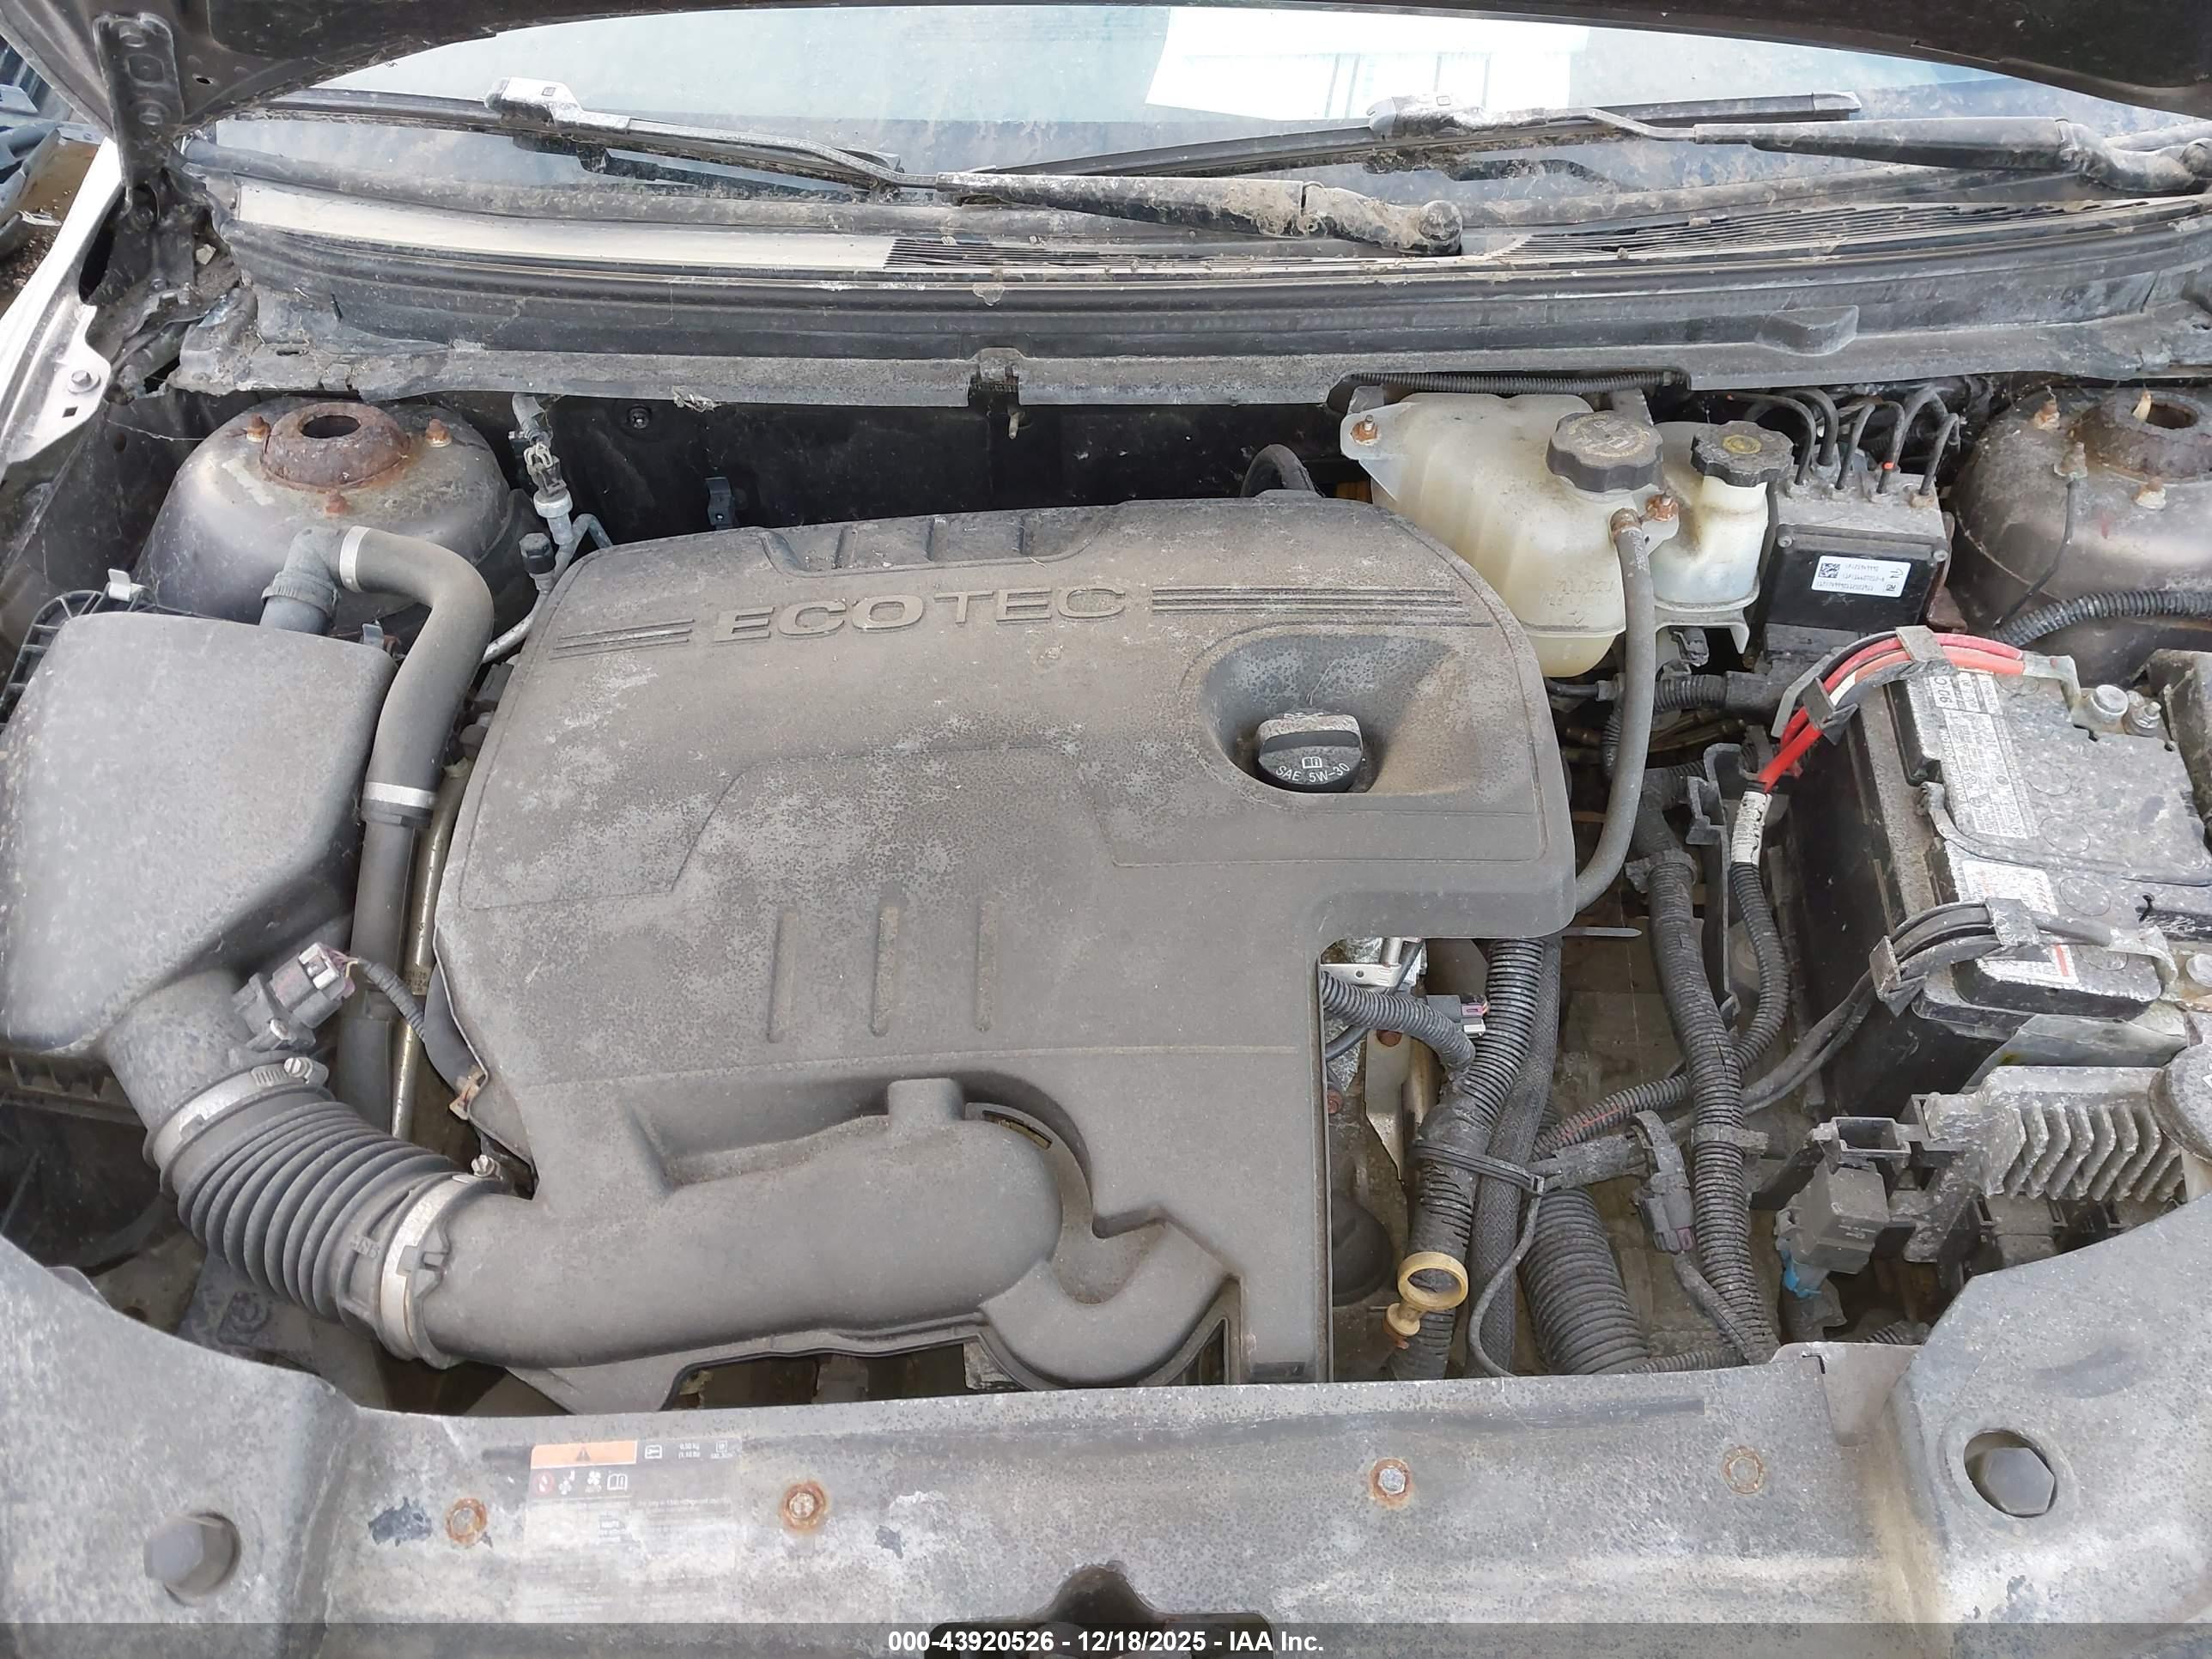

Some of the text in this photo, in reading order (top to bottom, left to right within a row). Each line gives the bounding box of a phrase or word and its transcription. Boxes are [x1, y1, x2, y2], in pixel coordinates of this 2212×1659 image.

[714, 582, 1127, 643] ECOTEC
[1275, 763, 1351, 783] SAE 5W-30
